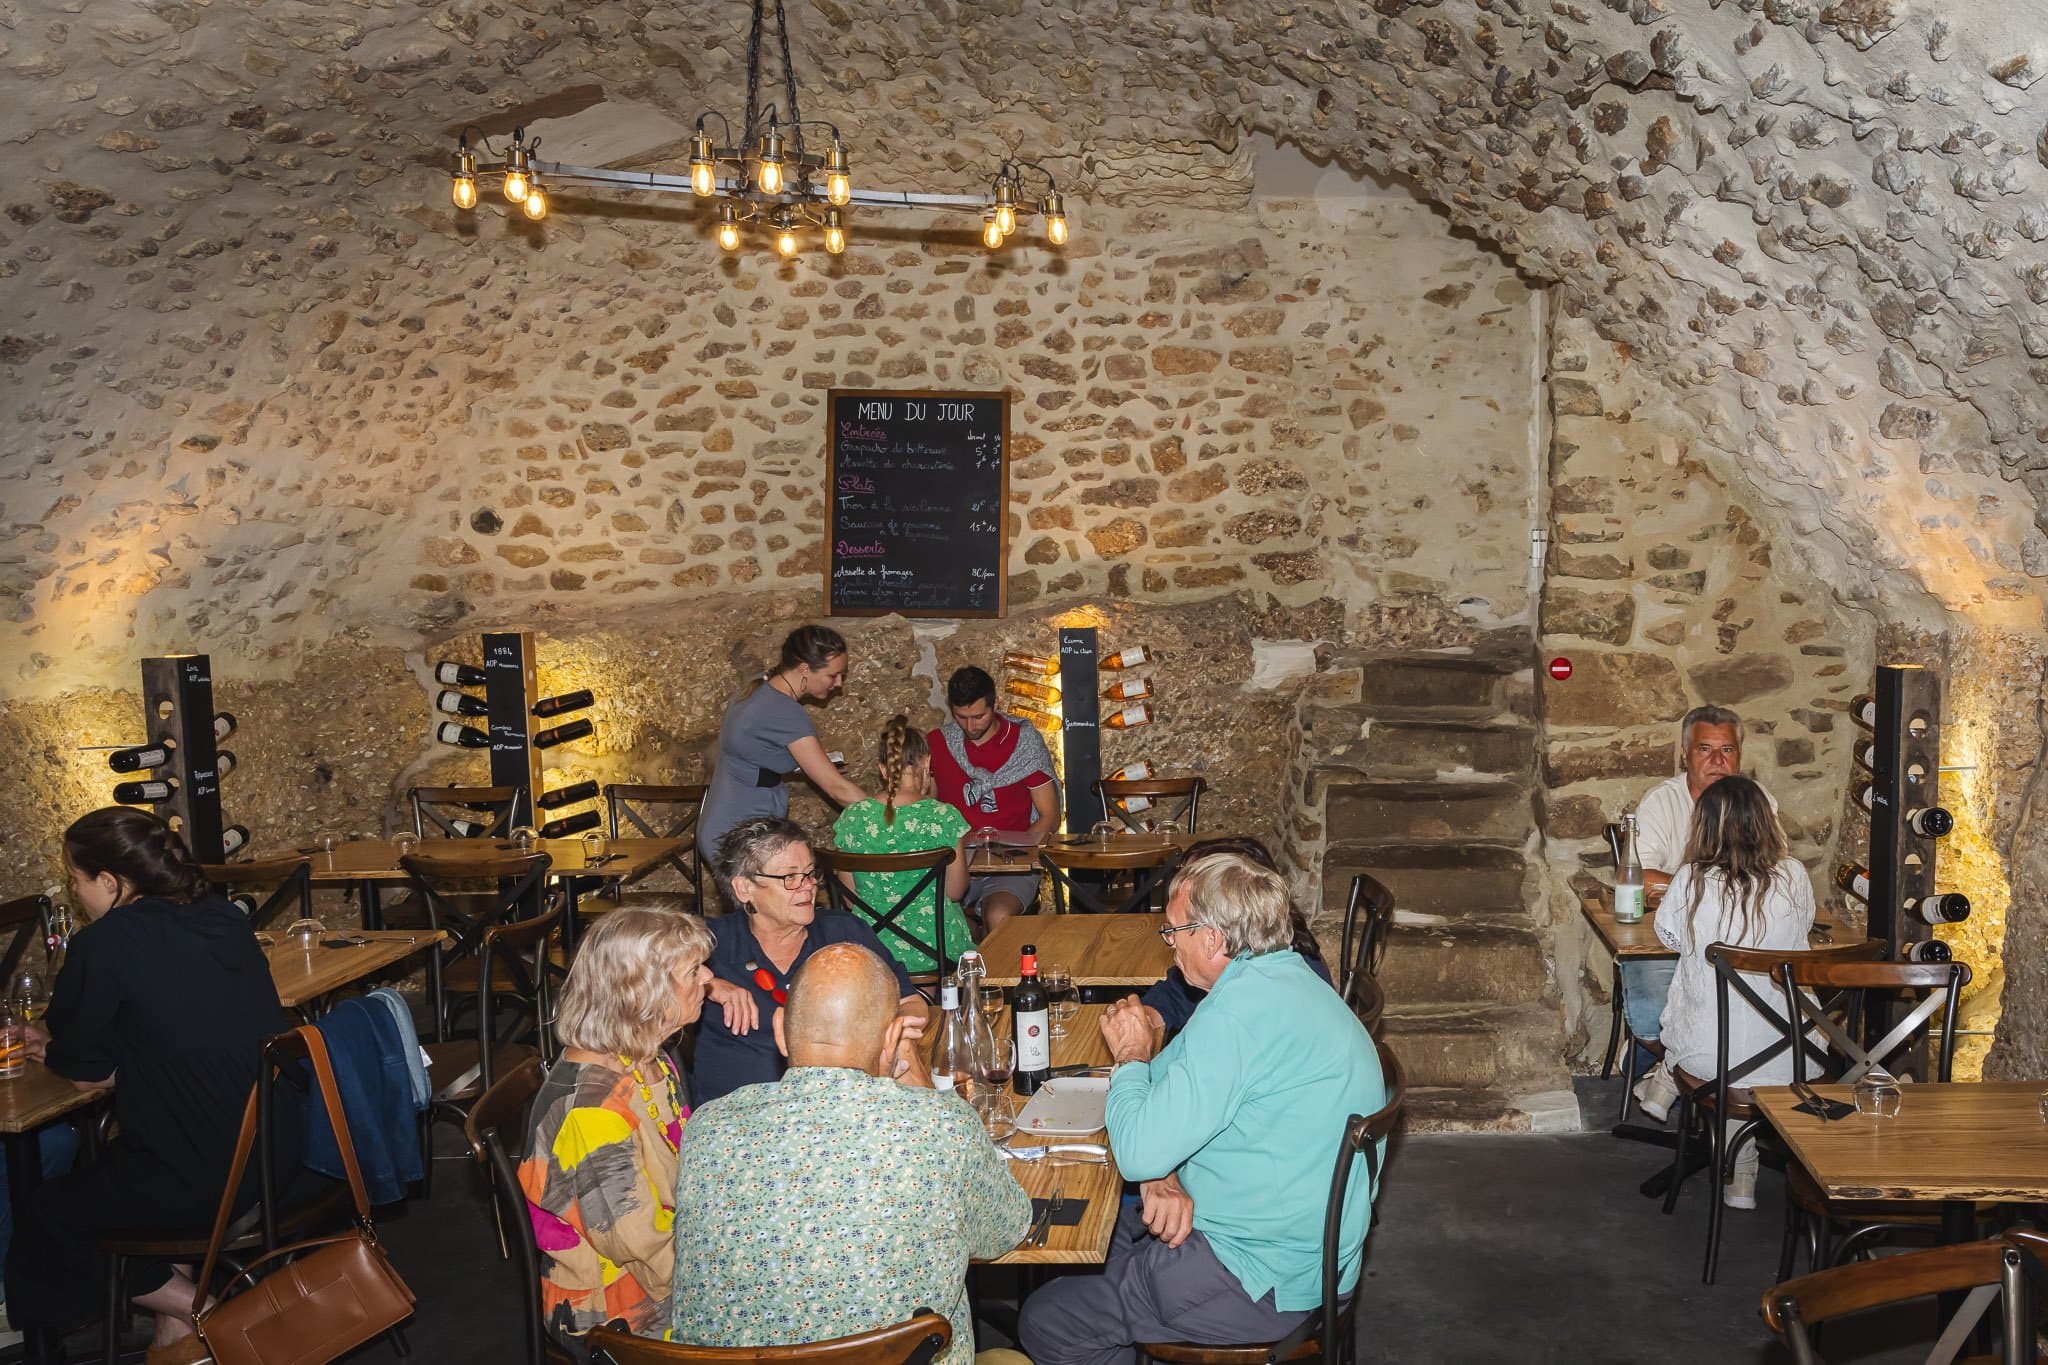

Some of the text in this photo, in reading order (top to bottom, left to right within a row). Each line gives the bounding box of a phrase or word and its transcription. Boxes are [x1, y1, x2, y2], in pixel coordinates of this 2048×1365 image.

[858, 402, 975, 422] MENU DU JOUR
[836, 540, 886, 556] Desserts
[837, 565, 865, 577] Assiette
[867, 567, 877, 576] de
[880, 564, 914, 580] fromages
